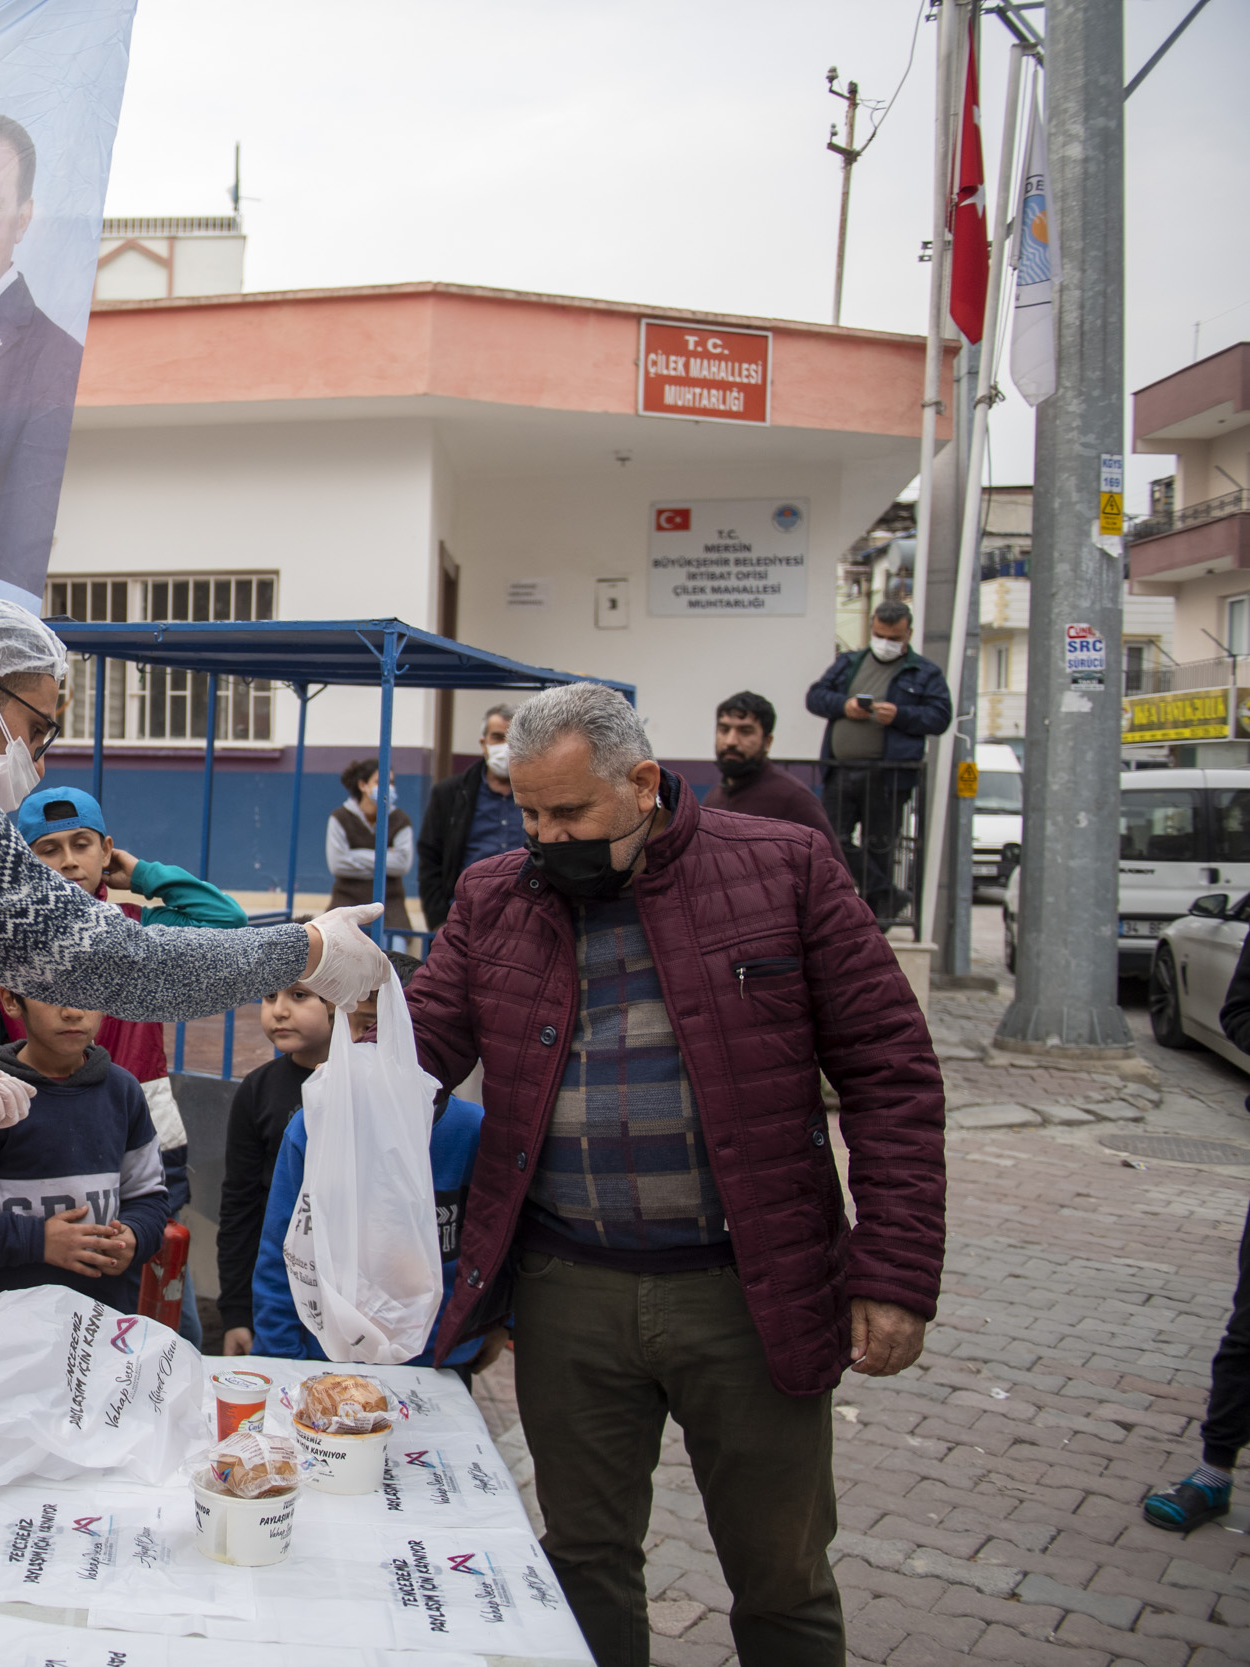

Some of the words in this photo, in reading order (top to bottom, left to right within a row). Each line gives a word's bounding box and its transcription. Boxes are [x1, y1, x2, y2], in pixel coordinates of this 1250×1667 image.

[647, 350, 686, 378] ÇİLEK
[689, 356, 763, 385] MAHALLESİ
[663, 384, 744, 412] MUHTARLIĞI
[716, 529, 739, 540] T.C.
[703, 542, 752, 554] MERSİN
[652, 555, 731, 569] BÜYÜKŞEHİR
[733, 553, 804, 567] BELEDİYESİ
[735, 569, 768, 581] OFİSİ
[672, 584, 707, 598] ÇİLEK
[710, 582, 781, 595] MAHALLESİ
[687, 598, 765, 609] MUHTARLIĞI
[1067, 639, 1103, 653] SRC
[77, 1348, 92, 1377] İÇİN
[115, 1360, 134, 1386] Seçer
[148, 1372, 167, 1416] Afiyet
[105, 1388, 132, 1428] Vahap
[310, 1447, 347, 1460] KAYNIYOR
[408, 1539, 432, 1575] KAYNIYOR
[390, 1558, 419, 1608] TENCEREMİZ
[416, 1576, 439, 1593] İÇİN
[424, 1594, 449, 1634] PAYLAŞIM
